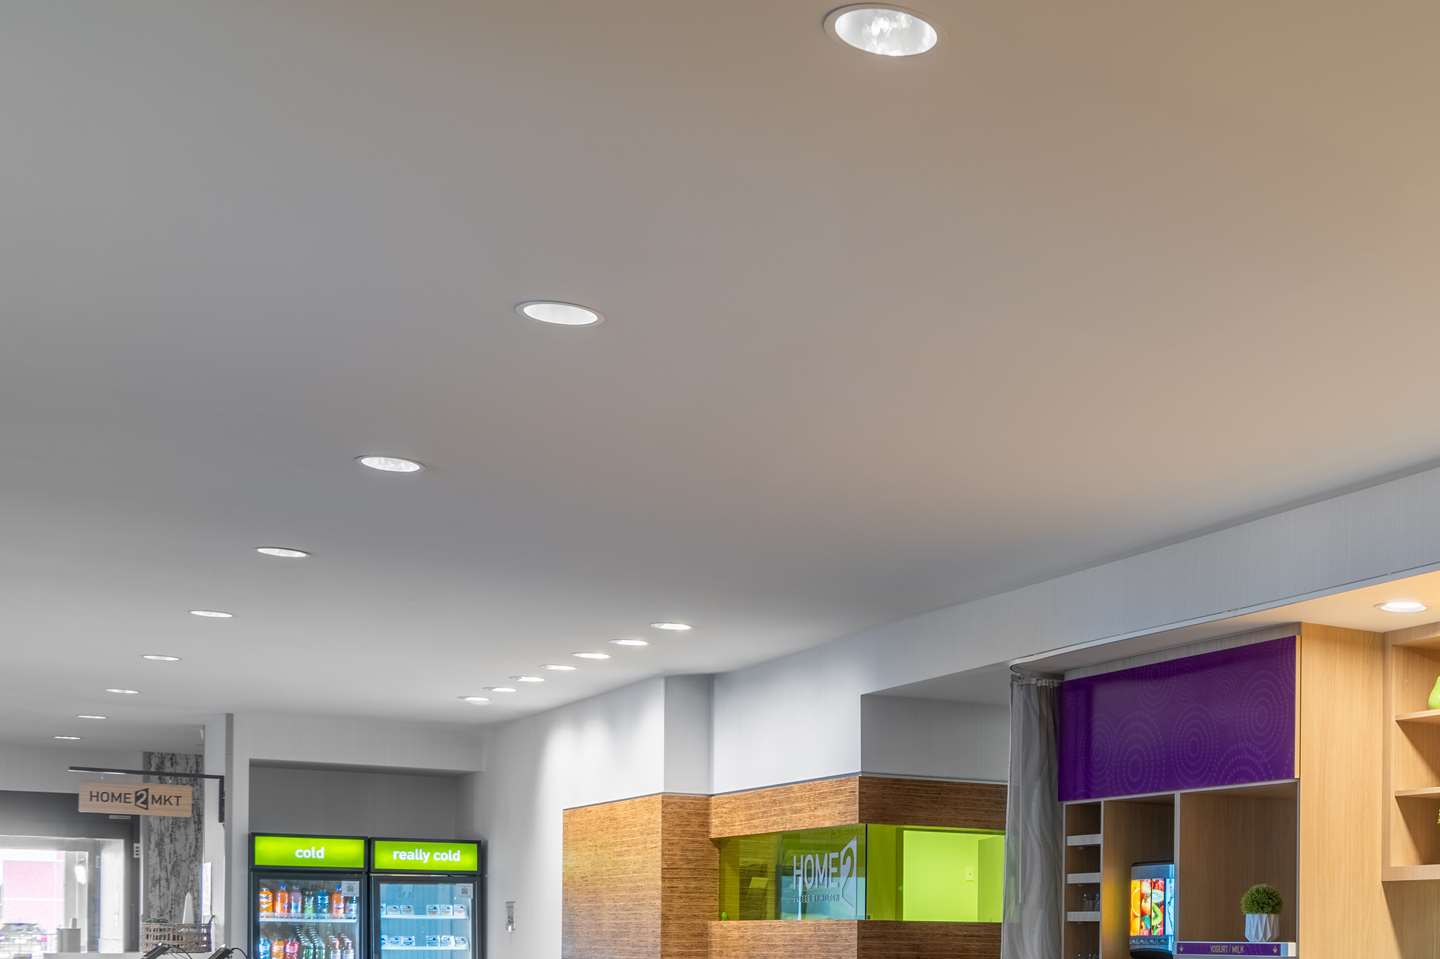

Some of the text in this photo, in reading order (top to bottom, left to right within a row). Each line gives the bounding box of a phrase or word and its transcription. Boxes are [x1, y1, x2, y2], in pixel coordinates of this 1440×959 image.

[295, 847, 325, 859] cold
[392, 849, 461, 863] really cold
